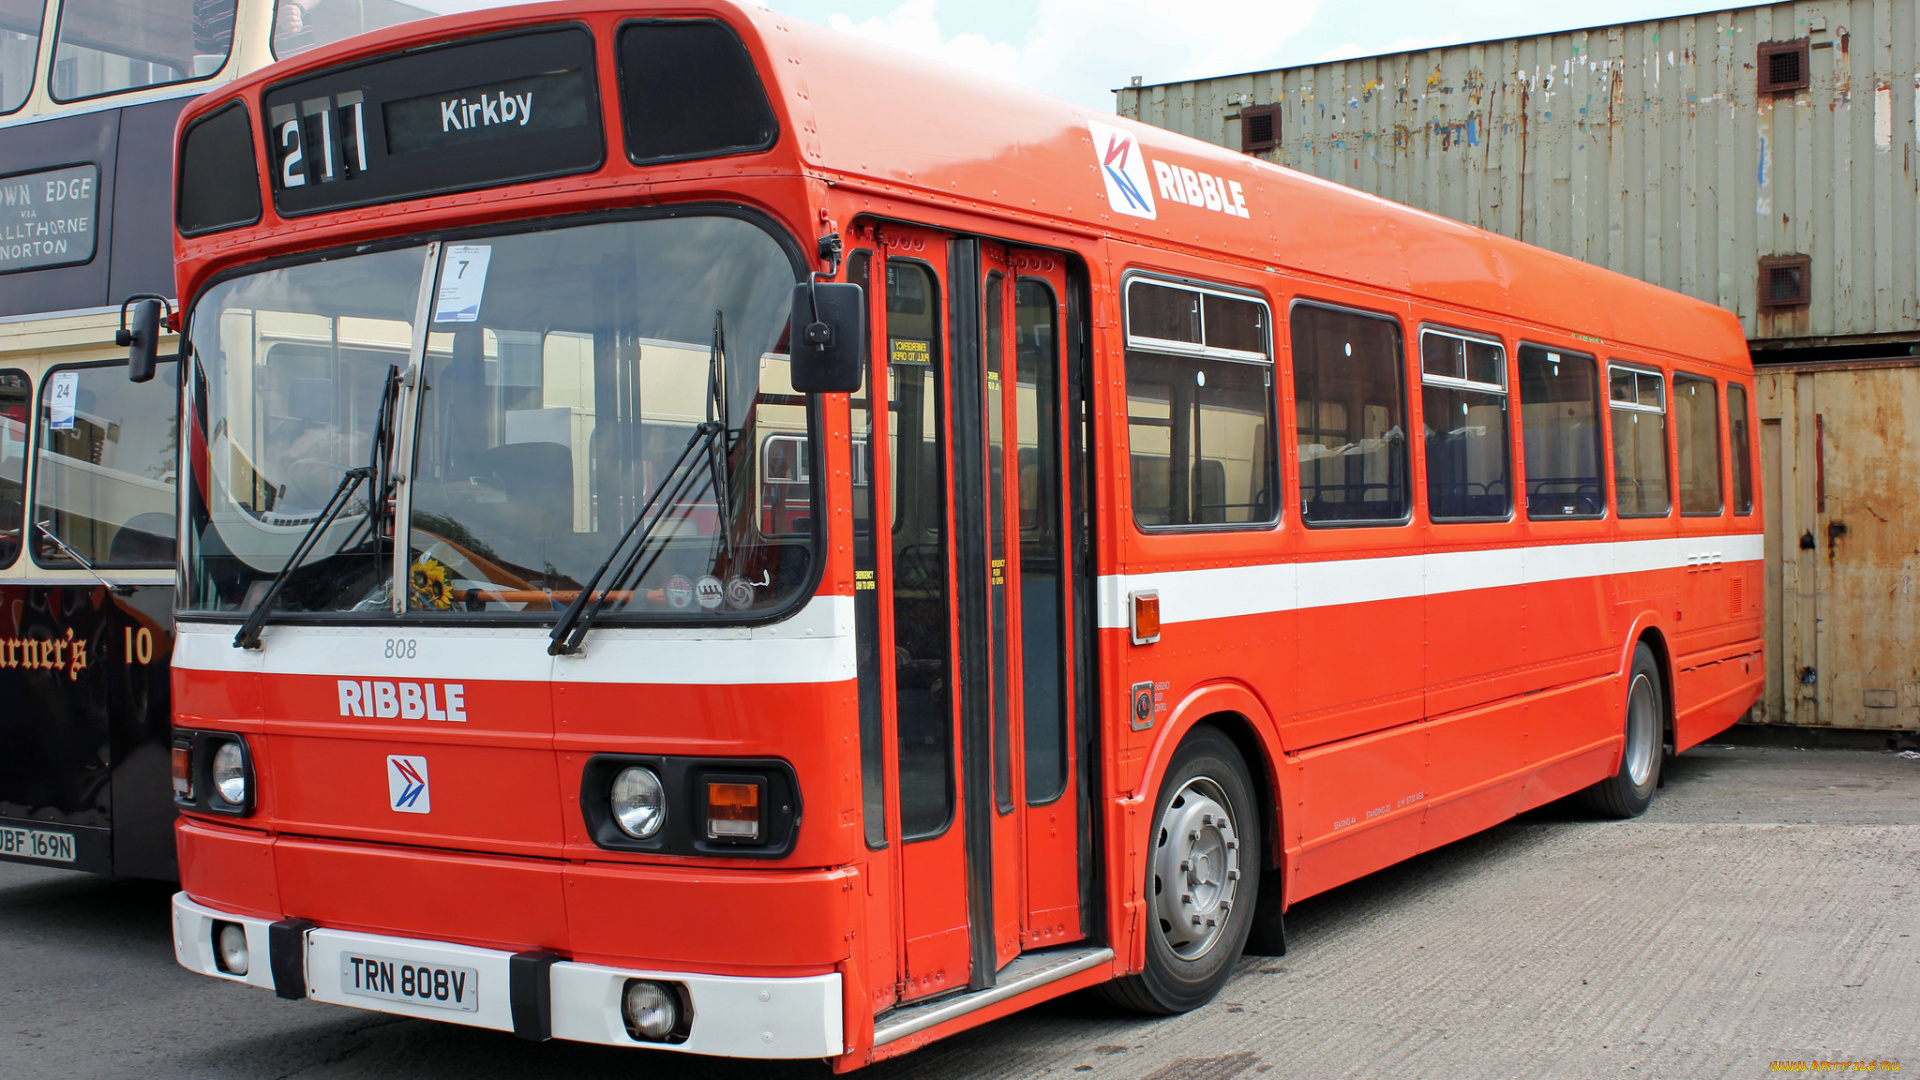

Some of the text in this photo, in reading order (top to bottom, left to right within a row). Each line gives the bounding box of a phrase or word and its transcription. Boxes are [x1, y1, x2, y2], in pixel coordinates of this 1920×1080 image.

[282, 91, 532, 188] 211 Kirkby
[46, 178, 92, 202] EDGE
[1152, 159, 1250, 219] RIBBLE
[20, 210, 37, 218] VIA
[0, 239, 67, 260] NORTON
[458, 260, 470, 279] 7
[56, 384, 70, 398] 24
[125, 626, 153, 665] 10
[384, 638, 417, 659] 808
[337, 679, 467, 722] RIBBLE
[31, 833, 71, 858] 169N
[350, 957, 466, 1003] TRN 808V
